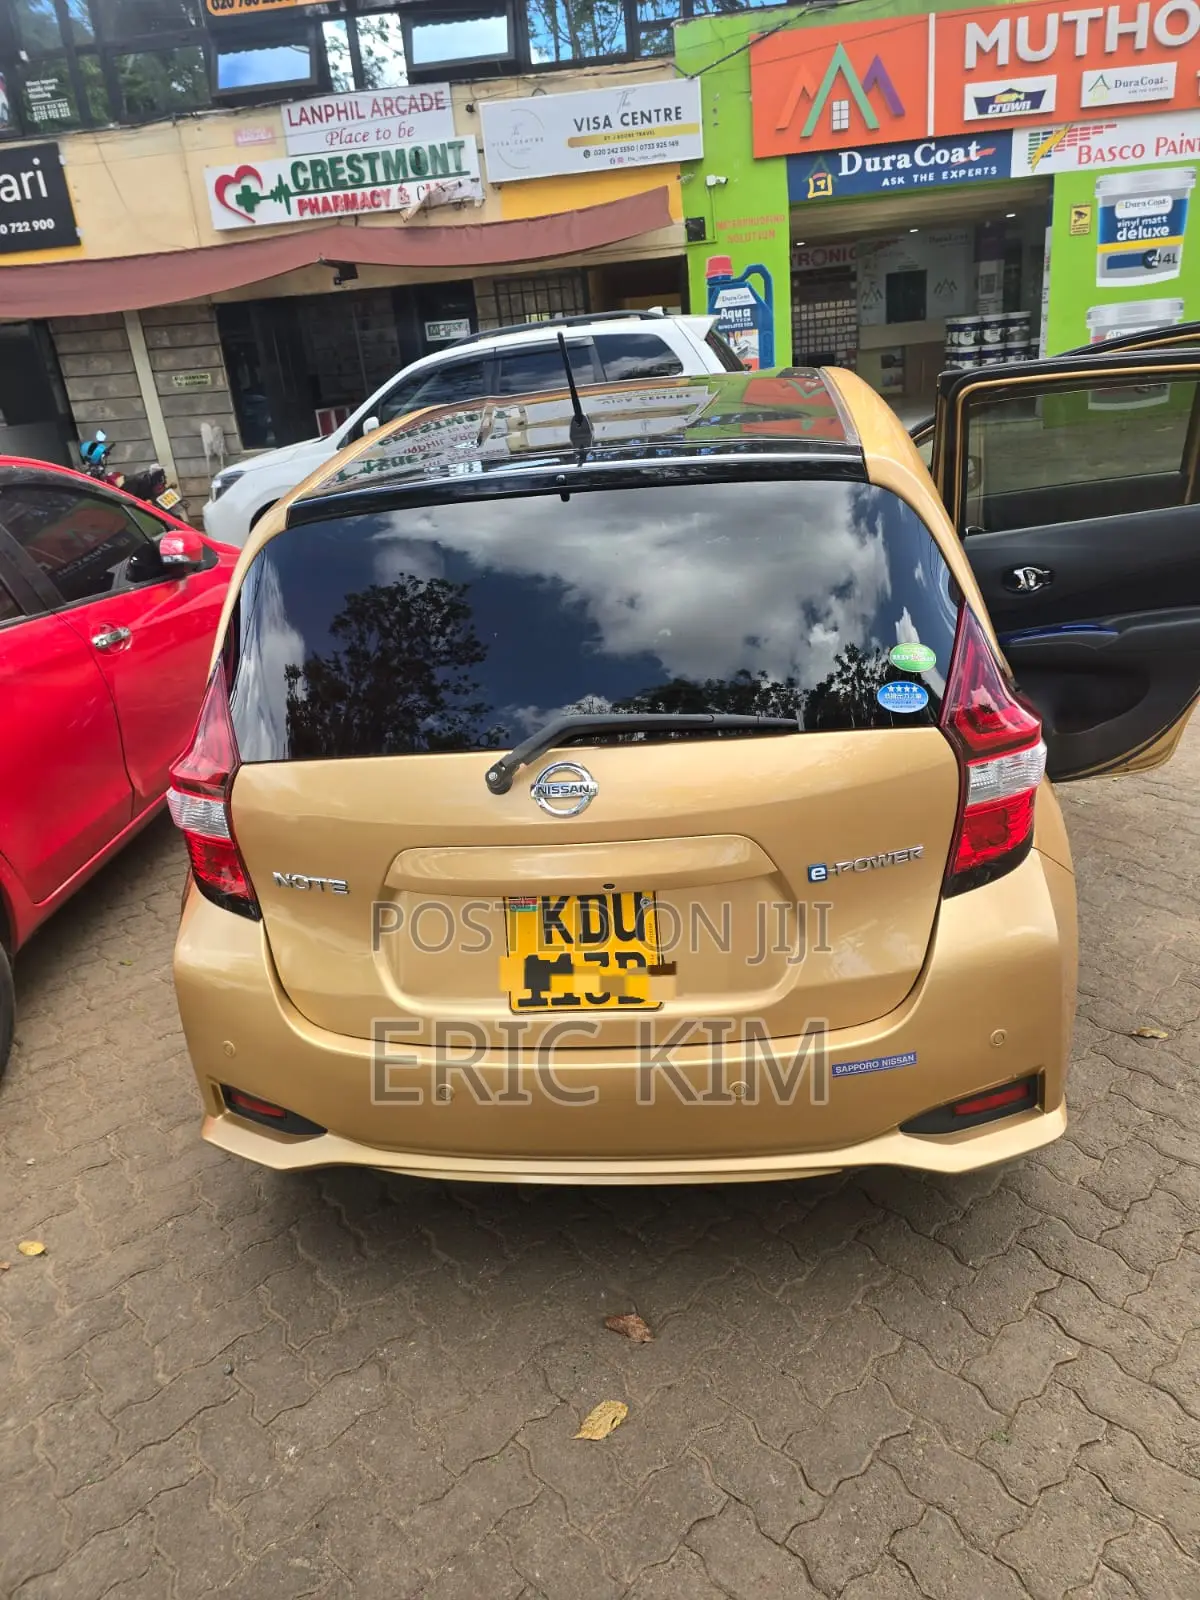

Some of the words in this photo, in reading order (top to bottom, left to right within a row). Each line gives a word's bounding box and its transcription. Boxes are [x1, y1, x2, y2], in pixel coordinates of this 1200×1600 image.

[964, 0, 1200, 70] MUTHO
[1114, 76, 1164, 88] DuraCoat
[287, 101, 366, 127] LANPHIL
[370, 90, 446, 118] ARCADE
[987, 100, 1032, 113] crown
[573, 115, 613, 132] VISA
[620, 106, 683, 127] CENTRE
[325, 128, 370, 146] Place
[376, 126, 391, 140] to
[398, 121, 415, 138] be
[838, 140, 981, 176] DuraCoat
[1077, 143, 1145, 165] BASCO
[290, 141, 465, 191] CRESTMONT
[881, 177, 905, 187] ASK
[913, 173, 935, 183] THE
[942, 166, 997, 180] EXPERTS
[297, 188, 391, 217] PHARMACY
[9, 221, 31, 234] 722
[32, 218, 55, 231] 900
[1116, 225, 1170, 241] deluxe
[1117, 217, 1140, 229] vinyl
[1141, 215, 1168, 225] matt
[720, 308, 751, 323] Aqua
[535, 784, 590, 796] NISSAN
[808, 845, 924, 883] e-POWER
[272, 870, 350, 895] NOTE
[541, 890, 646, 944] KDU
[835, 1059, 880, 1075] SAPPORO
[881, 1053, 915, 1068] NISSAN
